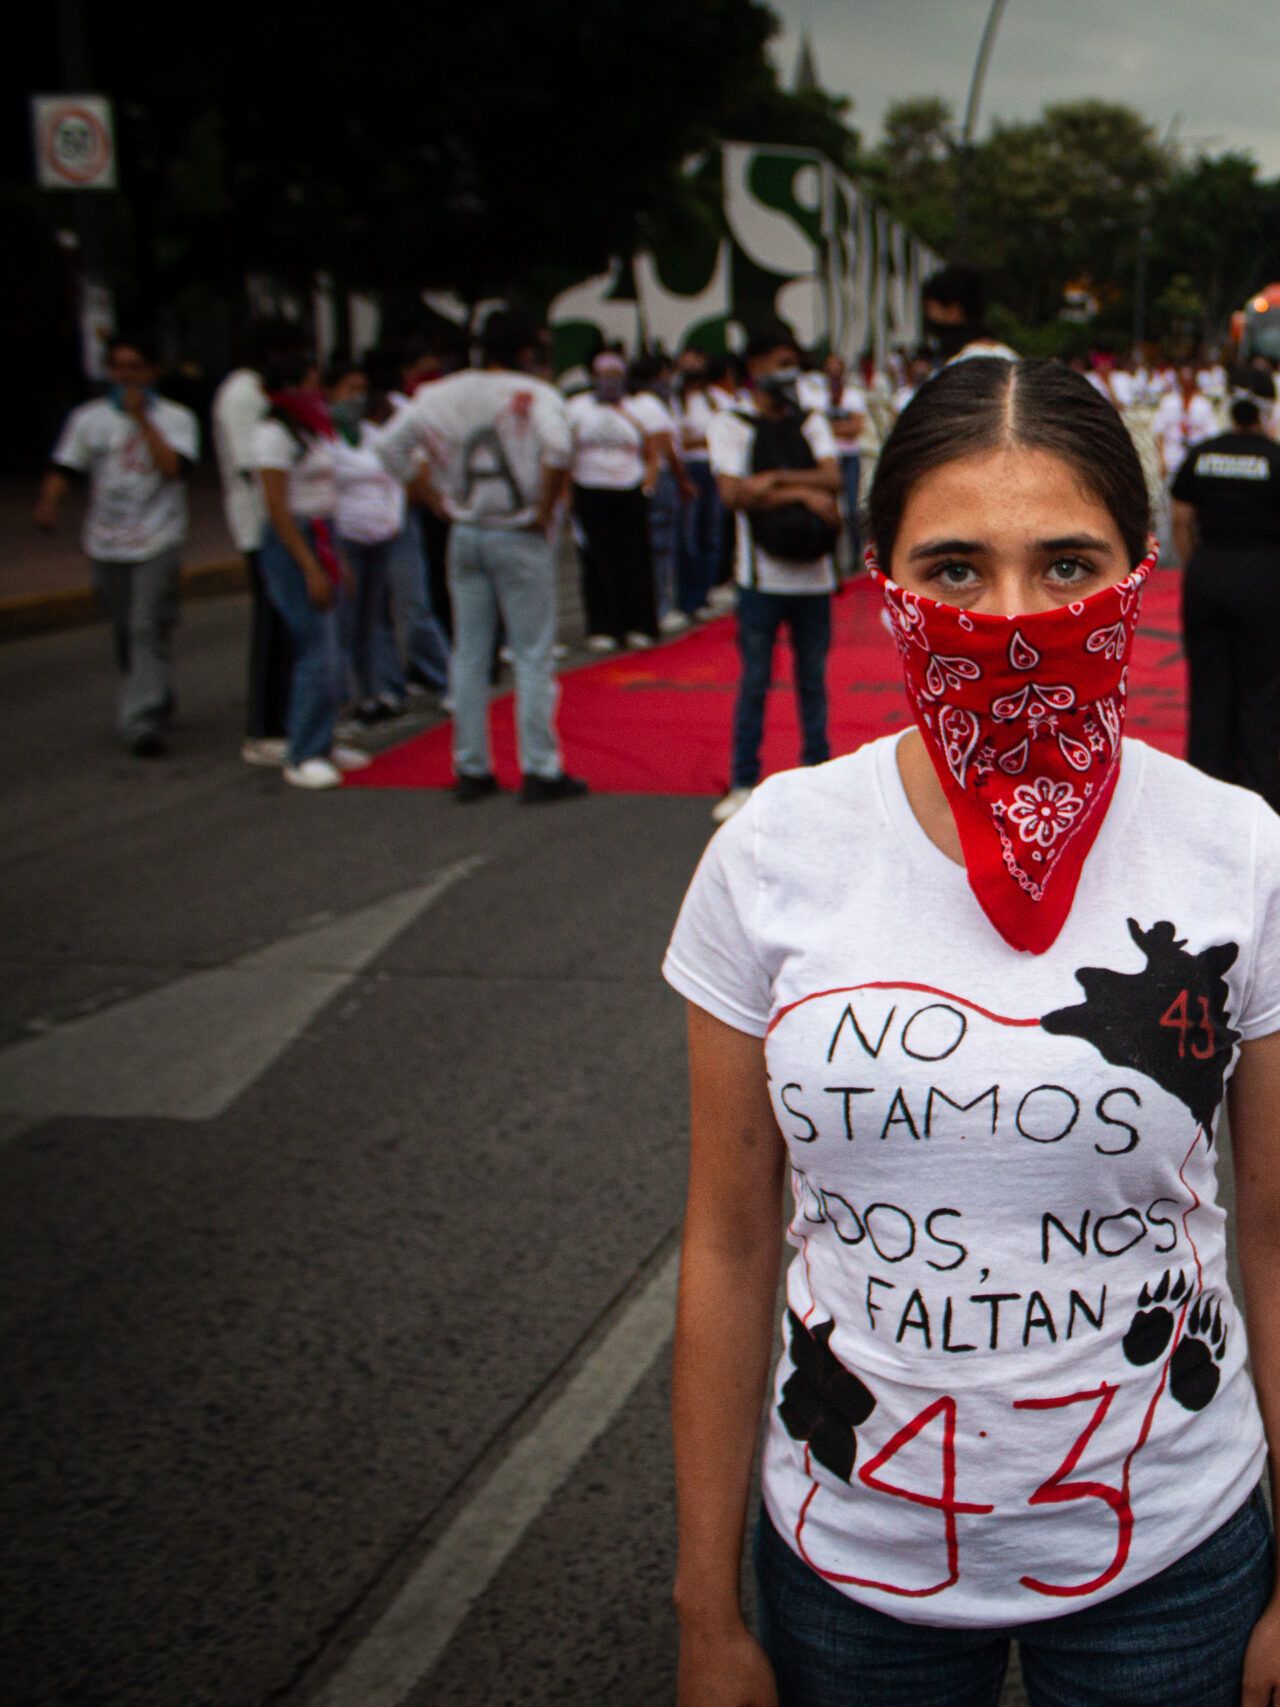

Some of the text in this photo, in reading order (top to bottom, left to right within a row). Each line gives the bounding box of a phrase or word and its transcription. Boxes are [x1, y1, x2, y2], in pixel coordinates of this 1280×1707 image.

[827, 1003, 968, 1063] NO
[1160, 989, 1215, 1059] 43
[766, 1072, 1143, 1156] STAMOS
[1041, 1197, 1180, 1265] NOS
[866, 1275, 1107, 1354] FALTAN
[859, 1381, 1136, 1598] 43
